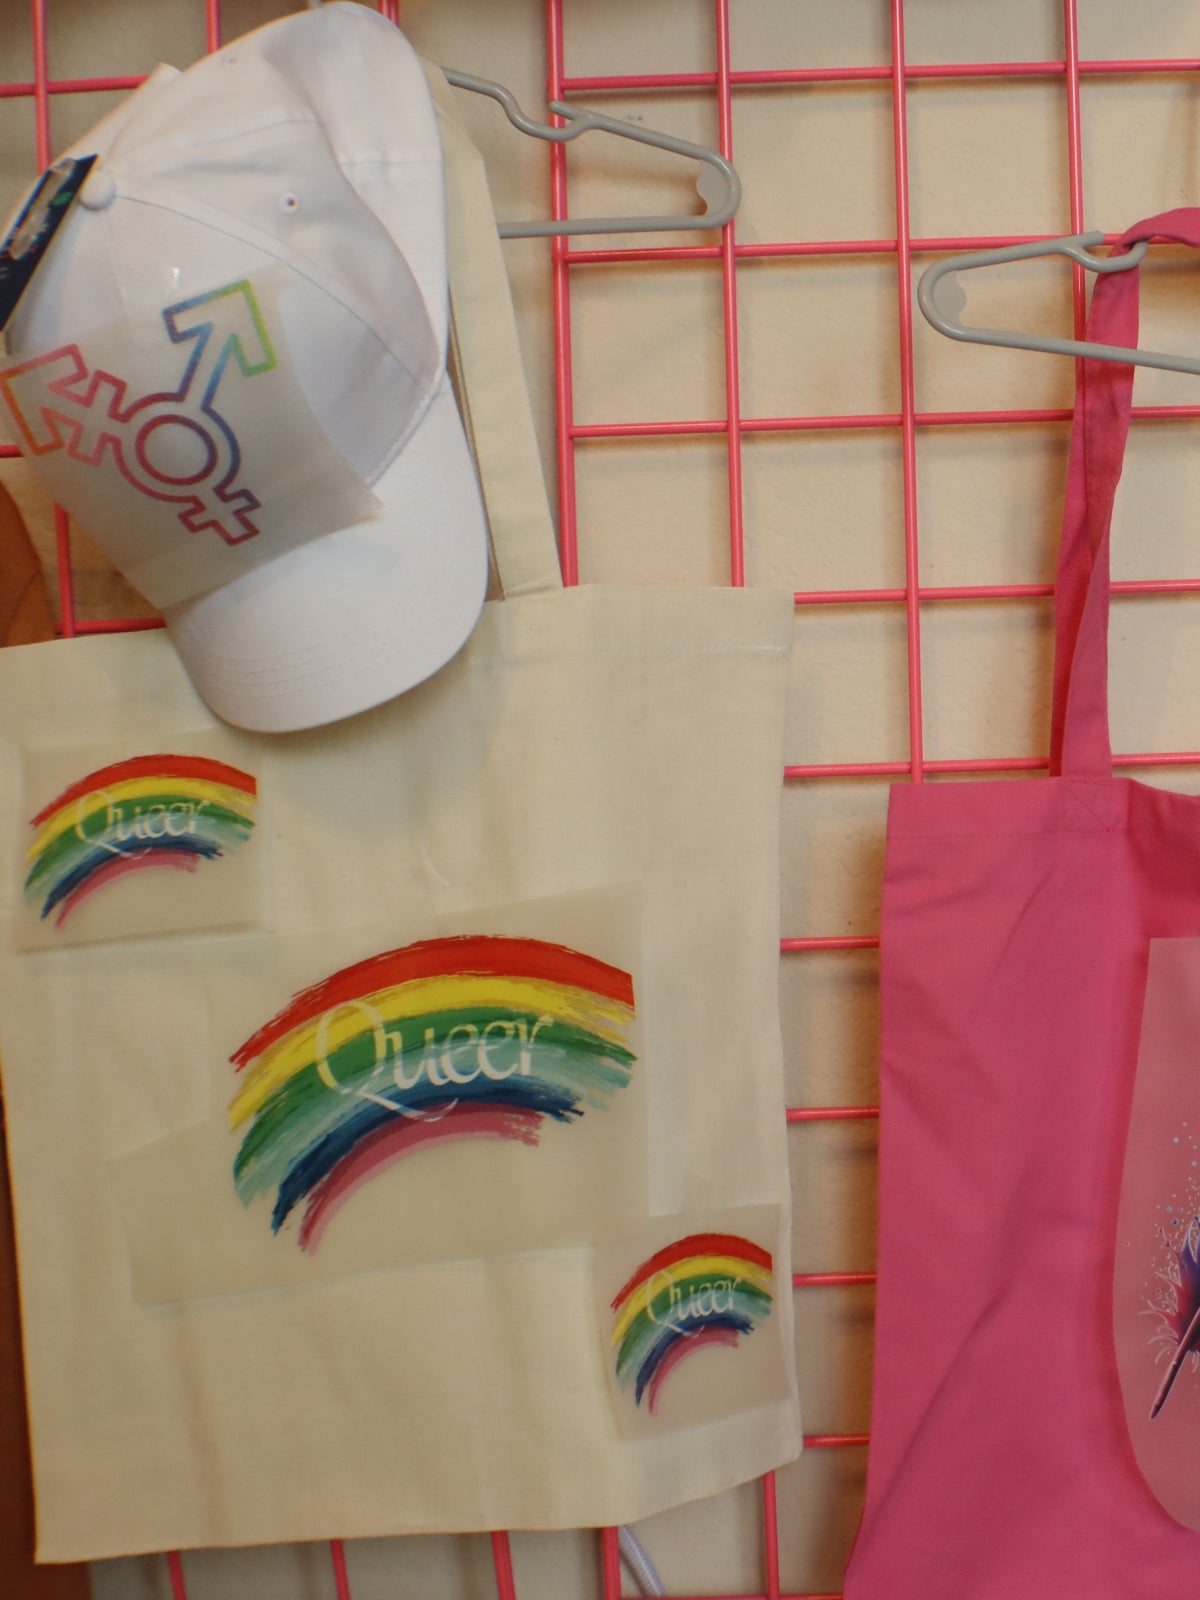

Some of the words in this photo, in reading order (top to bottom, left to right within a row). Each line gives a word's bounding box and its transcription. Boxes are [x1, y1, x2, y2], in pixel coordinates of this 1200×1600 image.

[75, 790, 210, 860] Queer
[315, 998, 555, 1122] Queer
[646, 1269, 742, 1339] Queer
